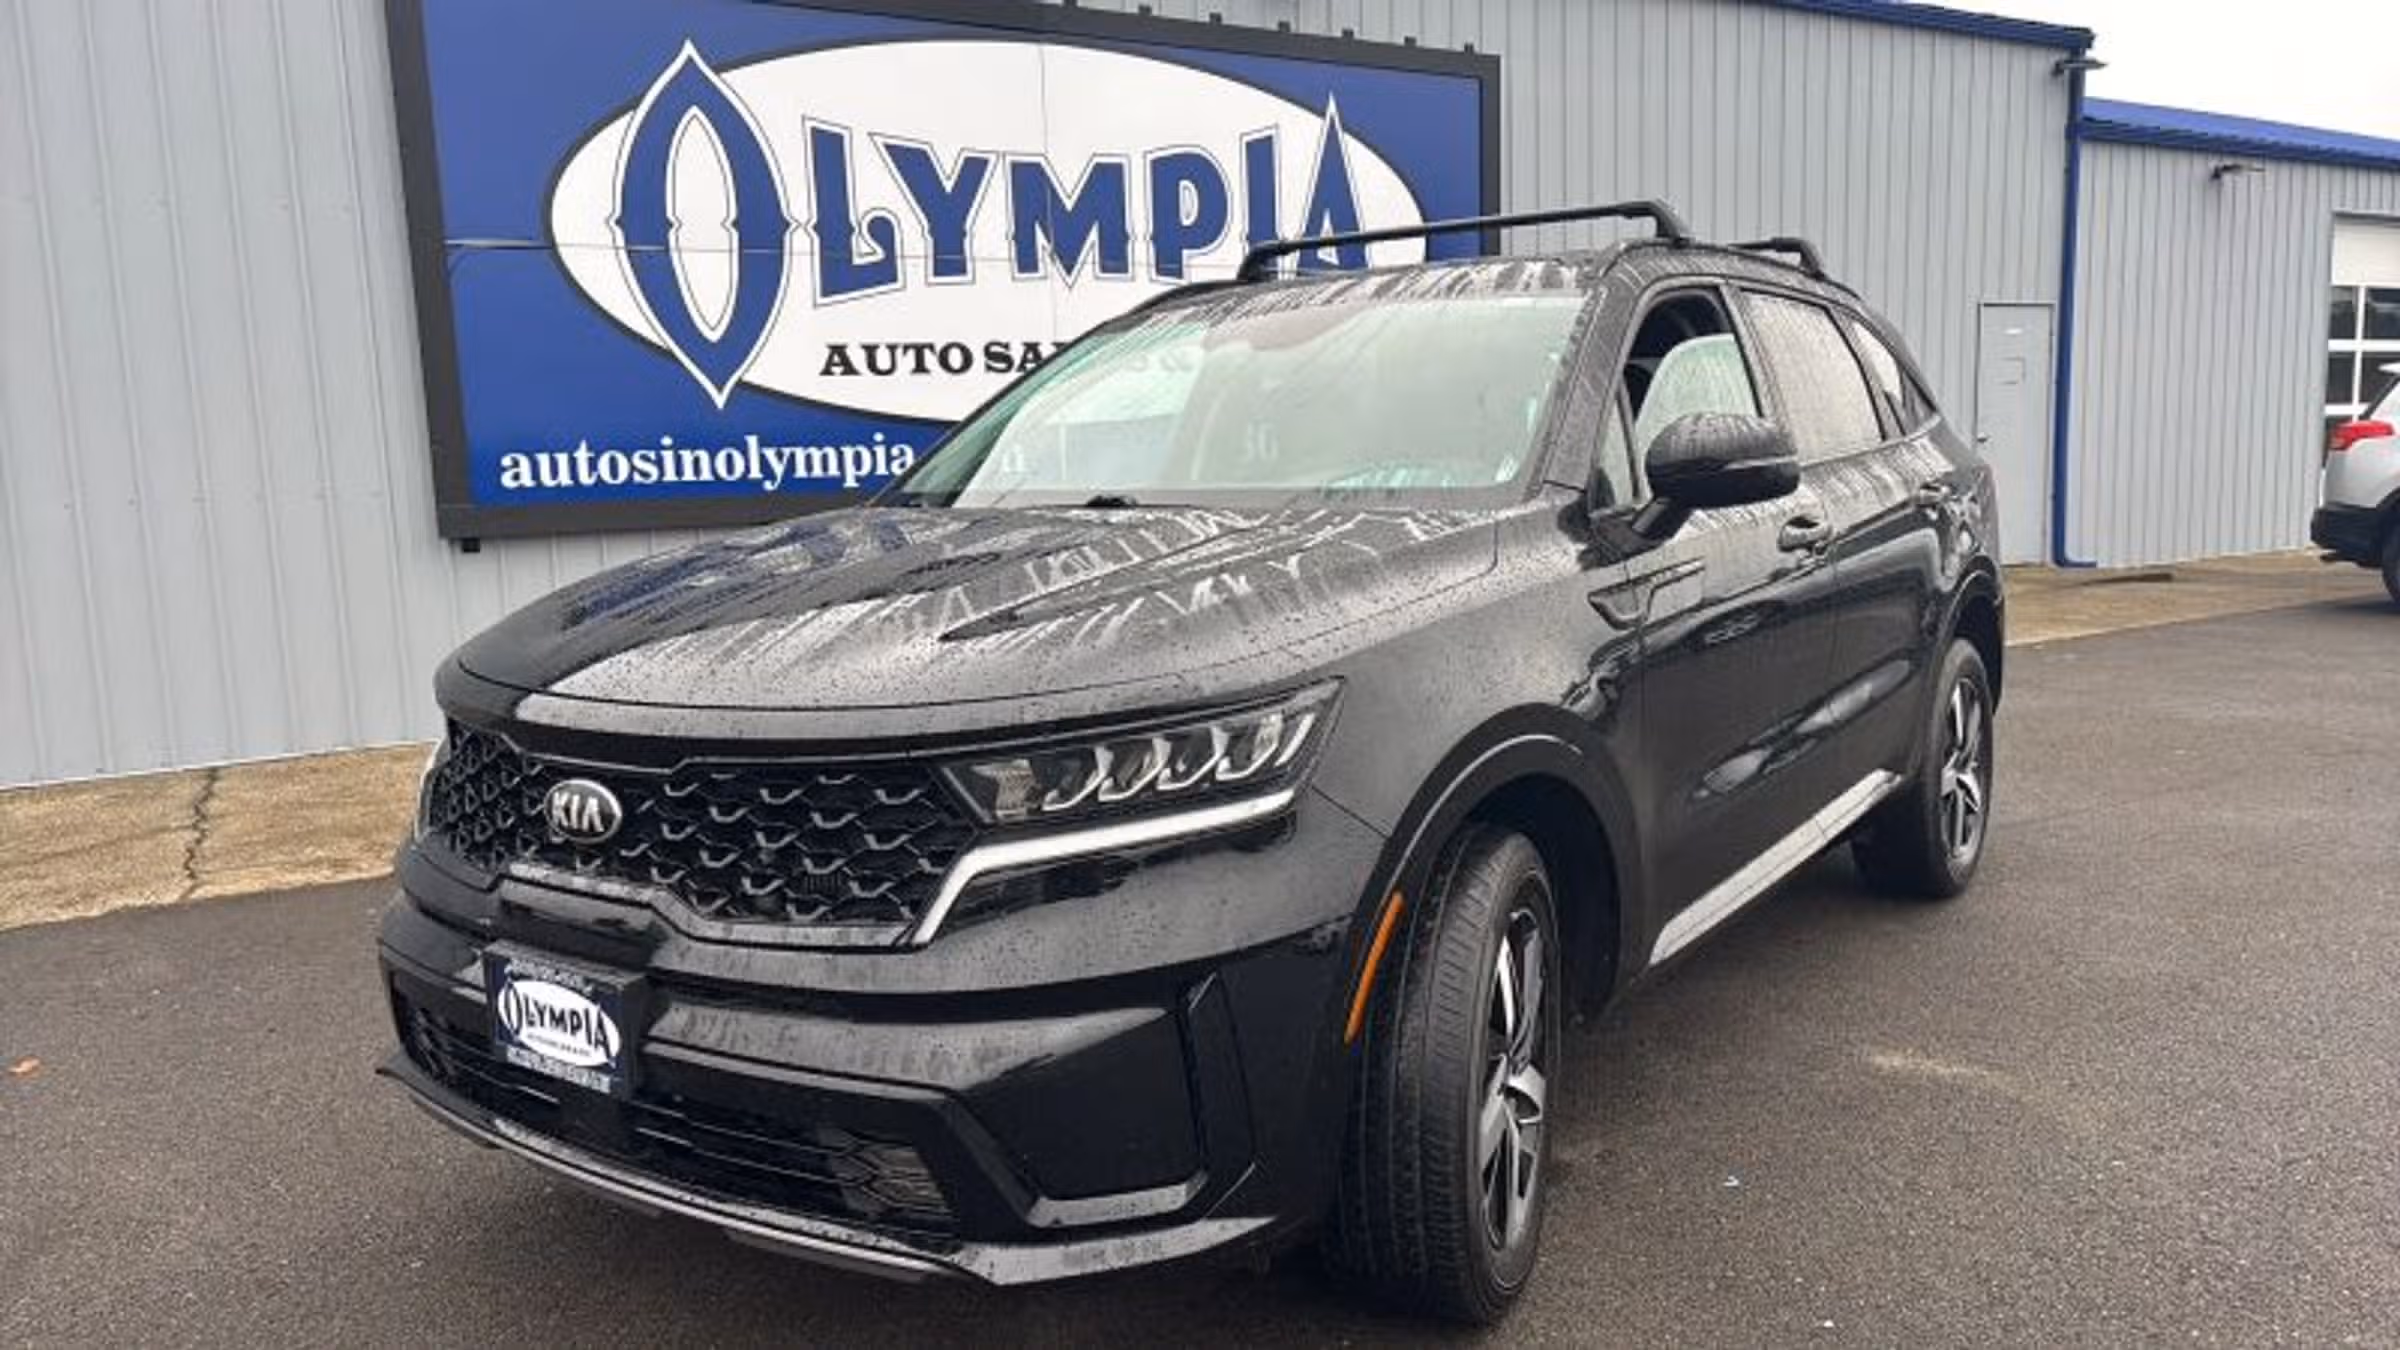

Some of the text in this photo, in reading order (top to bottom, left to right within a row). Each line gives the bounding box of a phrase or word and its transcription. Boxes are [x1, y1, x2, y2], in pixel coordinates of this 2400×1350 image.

[608, 40, 1372, 408] OLYMPIA
[819, 342, 974, 377] AUTO
[552, 791, 604, 832] KIA
[503, 976, 615, 1067] OLYMPIA
